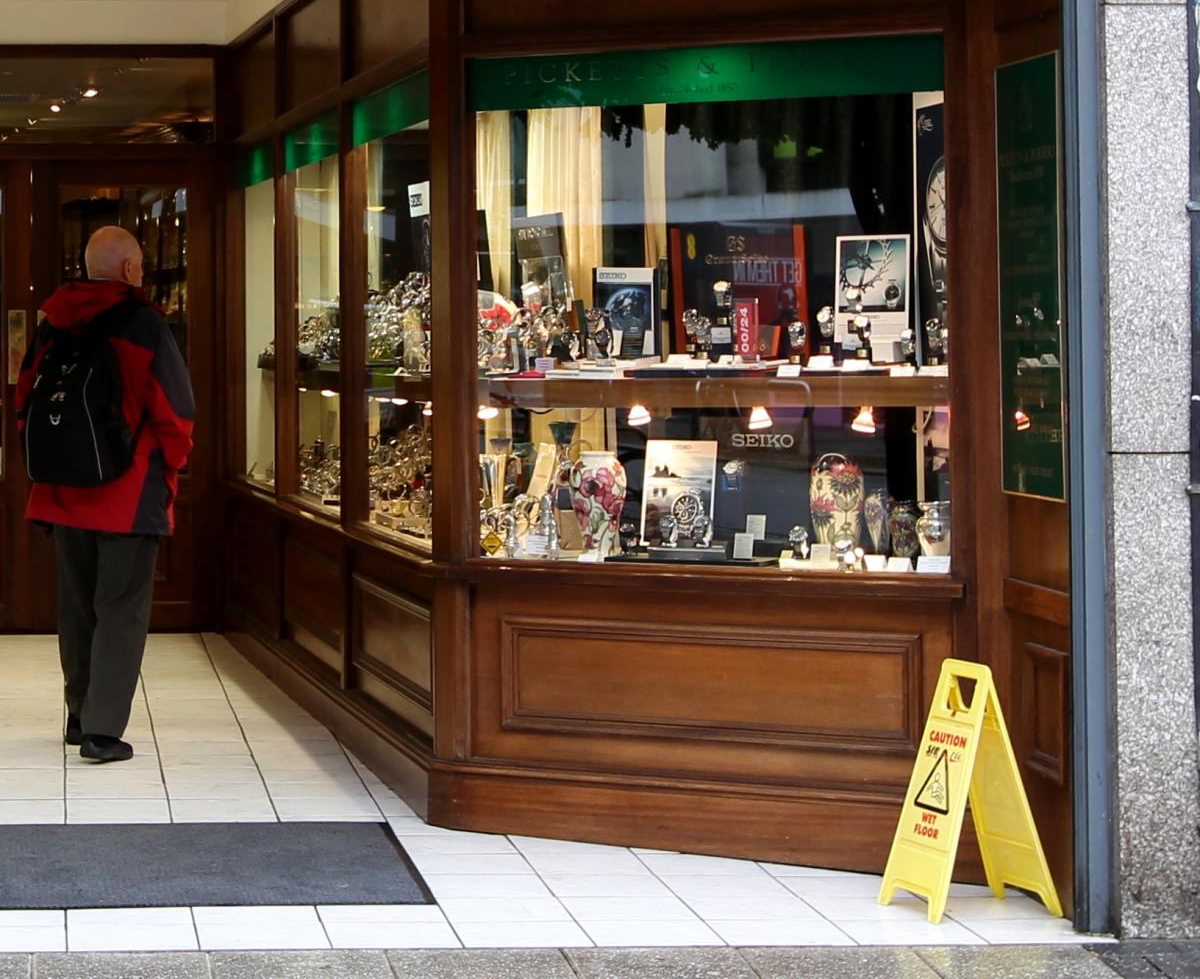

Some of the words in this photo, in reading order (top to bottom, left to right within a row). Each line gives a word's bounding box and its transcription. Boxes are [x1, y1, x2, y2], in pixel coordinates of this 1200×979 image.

[731, 433, 794, 448] SEIKO
[929, 730, 967, 748] CAUTION
[922, 812, 937, 825] WET
[914, 823, 939, 839] FLOOR
